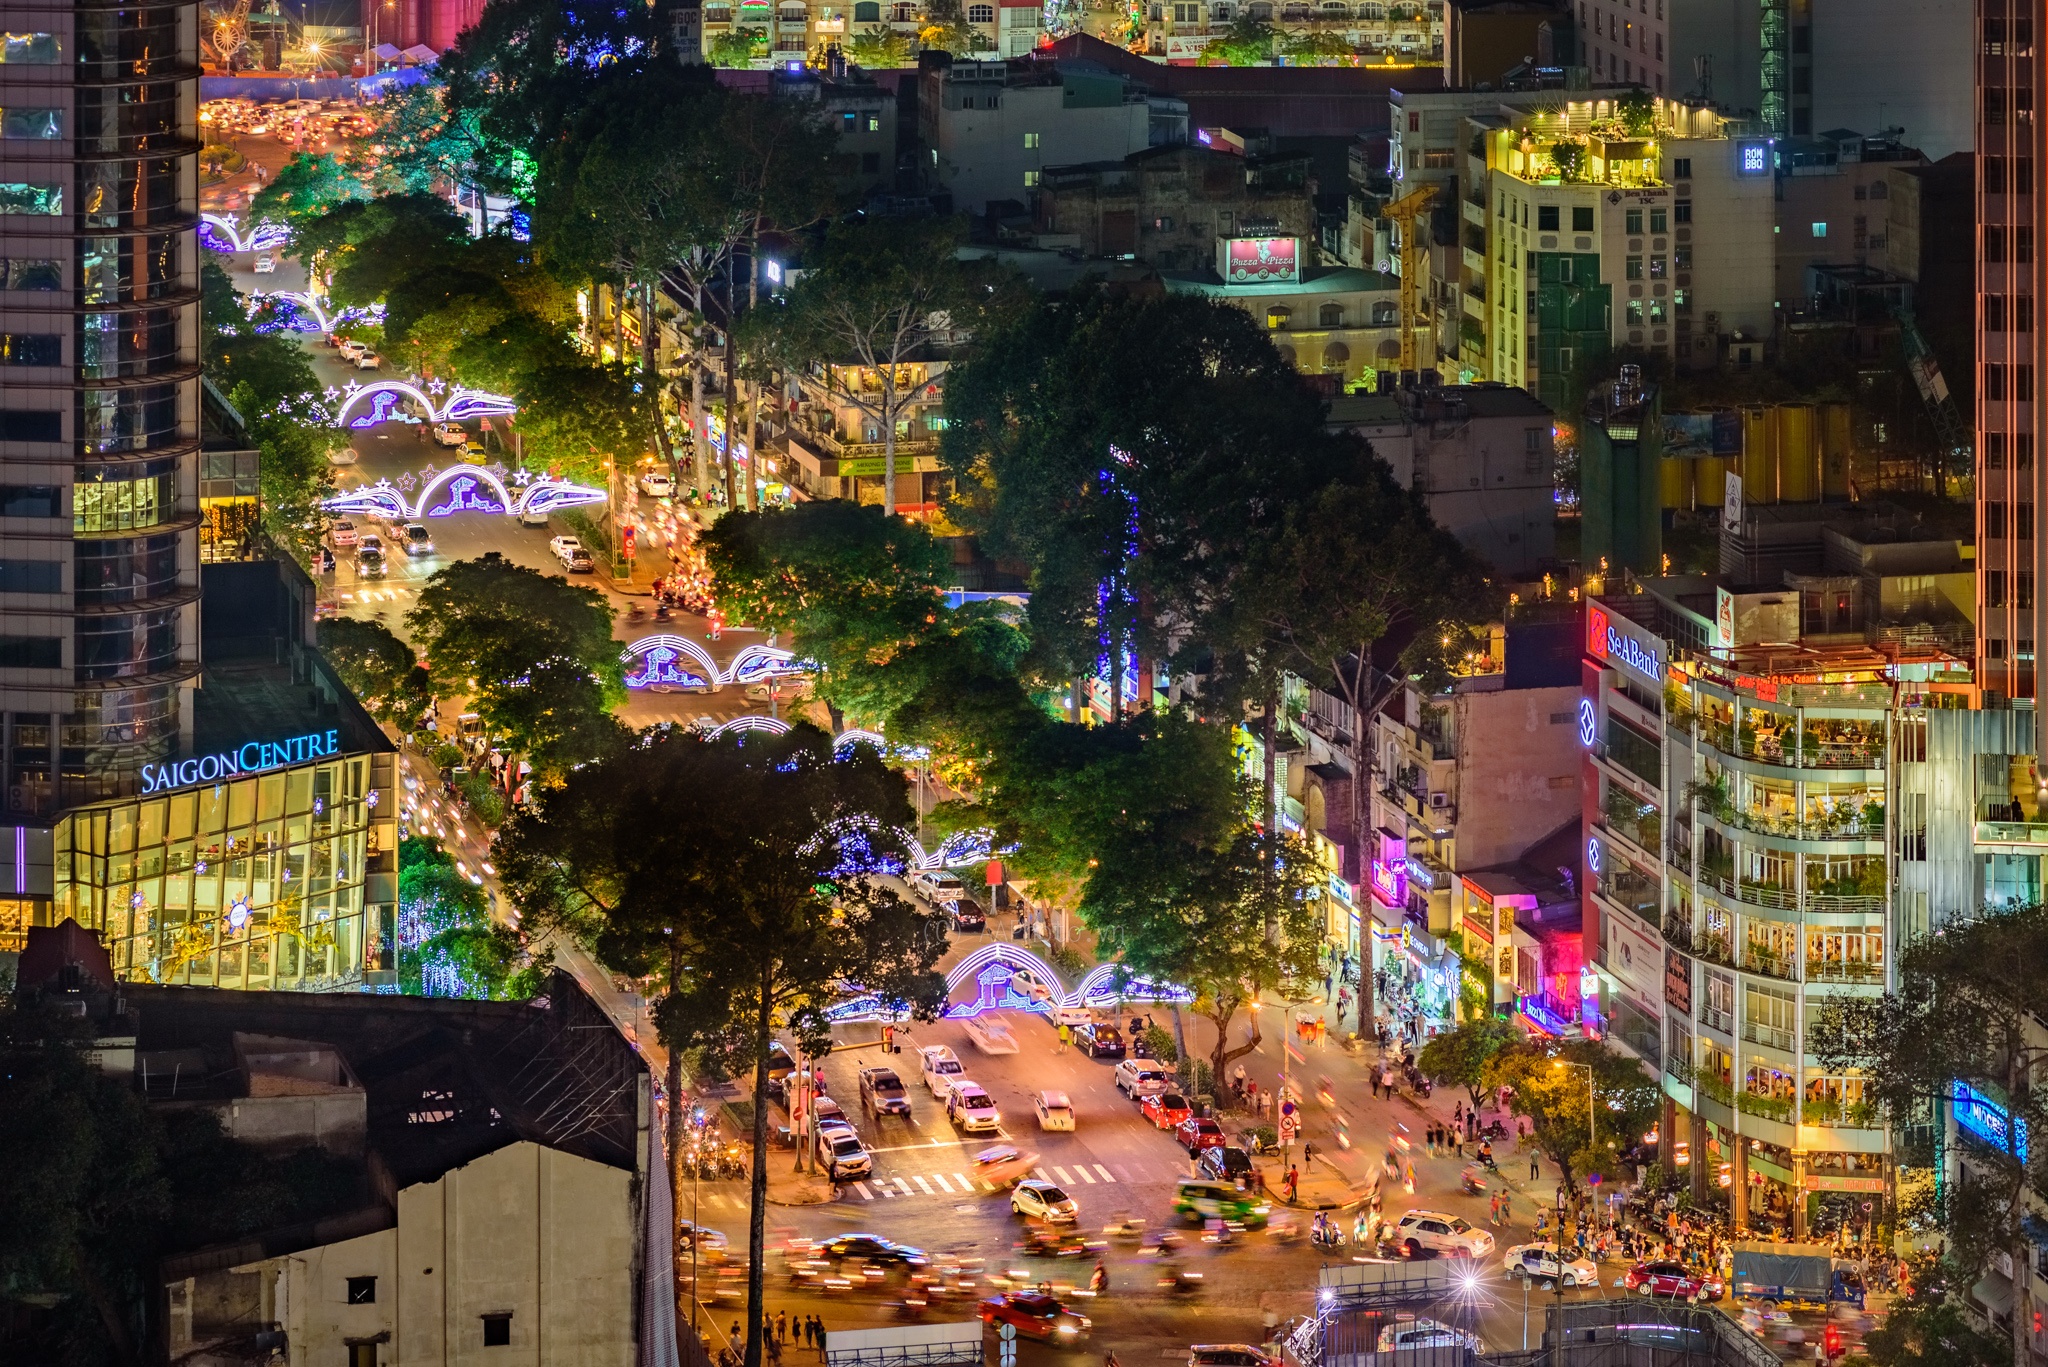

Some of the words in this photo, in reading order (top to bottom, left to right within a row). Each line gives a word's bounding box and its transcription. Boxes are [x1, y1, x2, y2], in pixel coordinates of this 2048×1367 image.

[1745, 159, 1762, 169] BBQ
[1641, 189, 1668, 197] Thanh
[1231, 258, 1258, 266] Buzza
[1267, 256, 1295, 265] Pizza
[1607, 626, 1660, 682] SeABank
[1793, 673, 1817, 685] Cream
